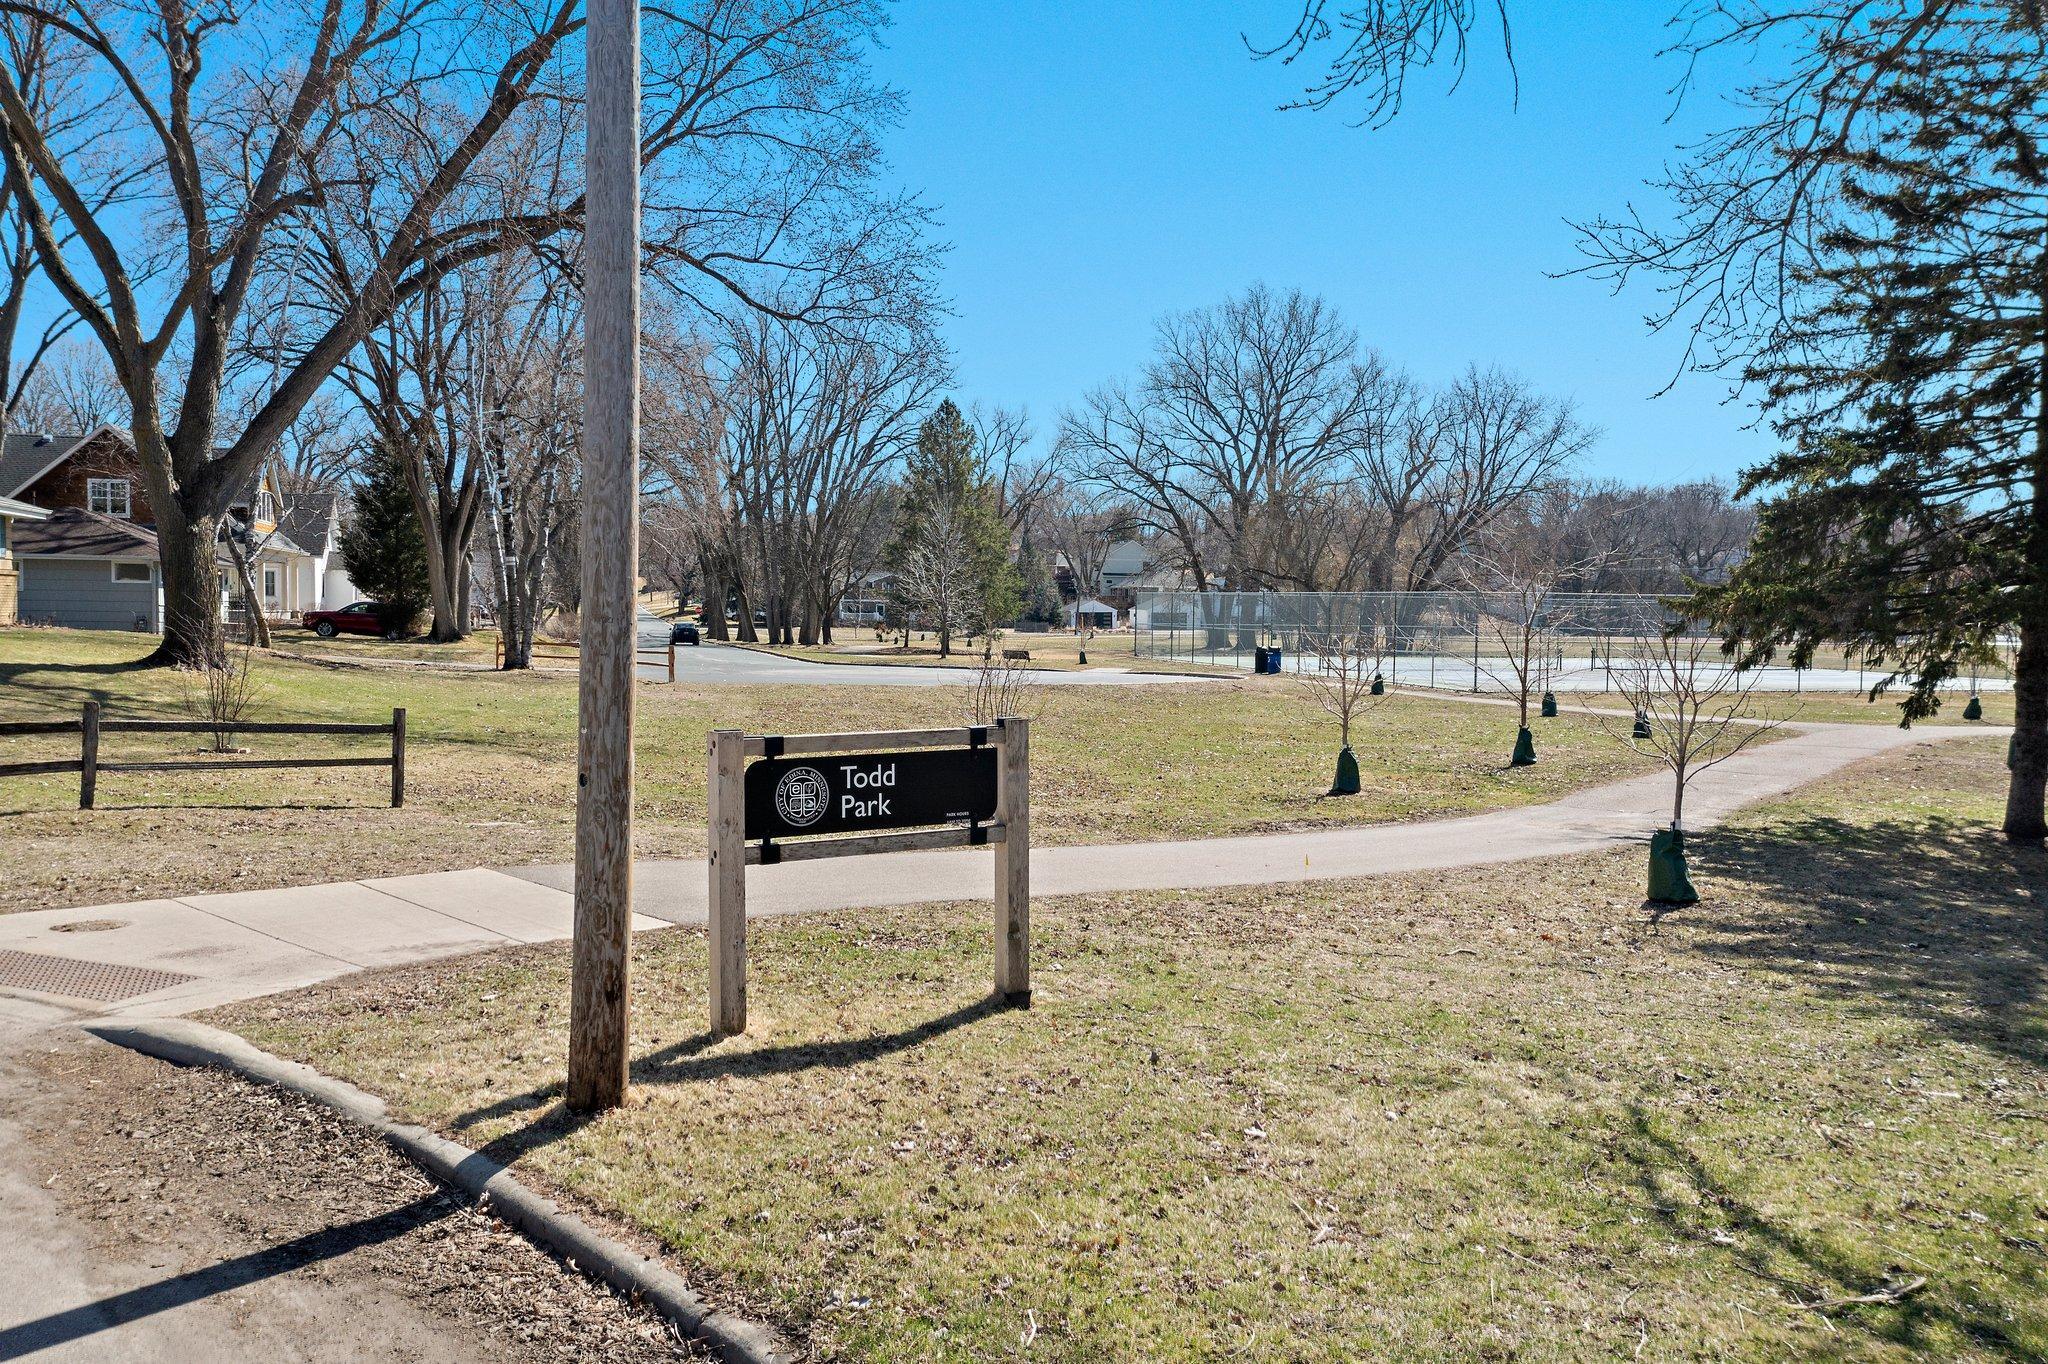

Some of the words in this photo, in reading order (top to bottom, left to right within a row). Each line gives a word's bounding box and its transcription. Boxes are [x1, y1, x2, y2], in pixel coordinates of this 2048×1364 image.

[840, 763, 896, 789] Todd
[778, 783, 786, 795] OF
[792, 785, 800, 794] e
[809, 771, 827, 813] MINNESOTA
[778, 797, 788, 815] CITY
[841, 793, 892, 819] Park
